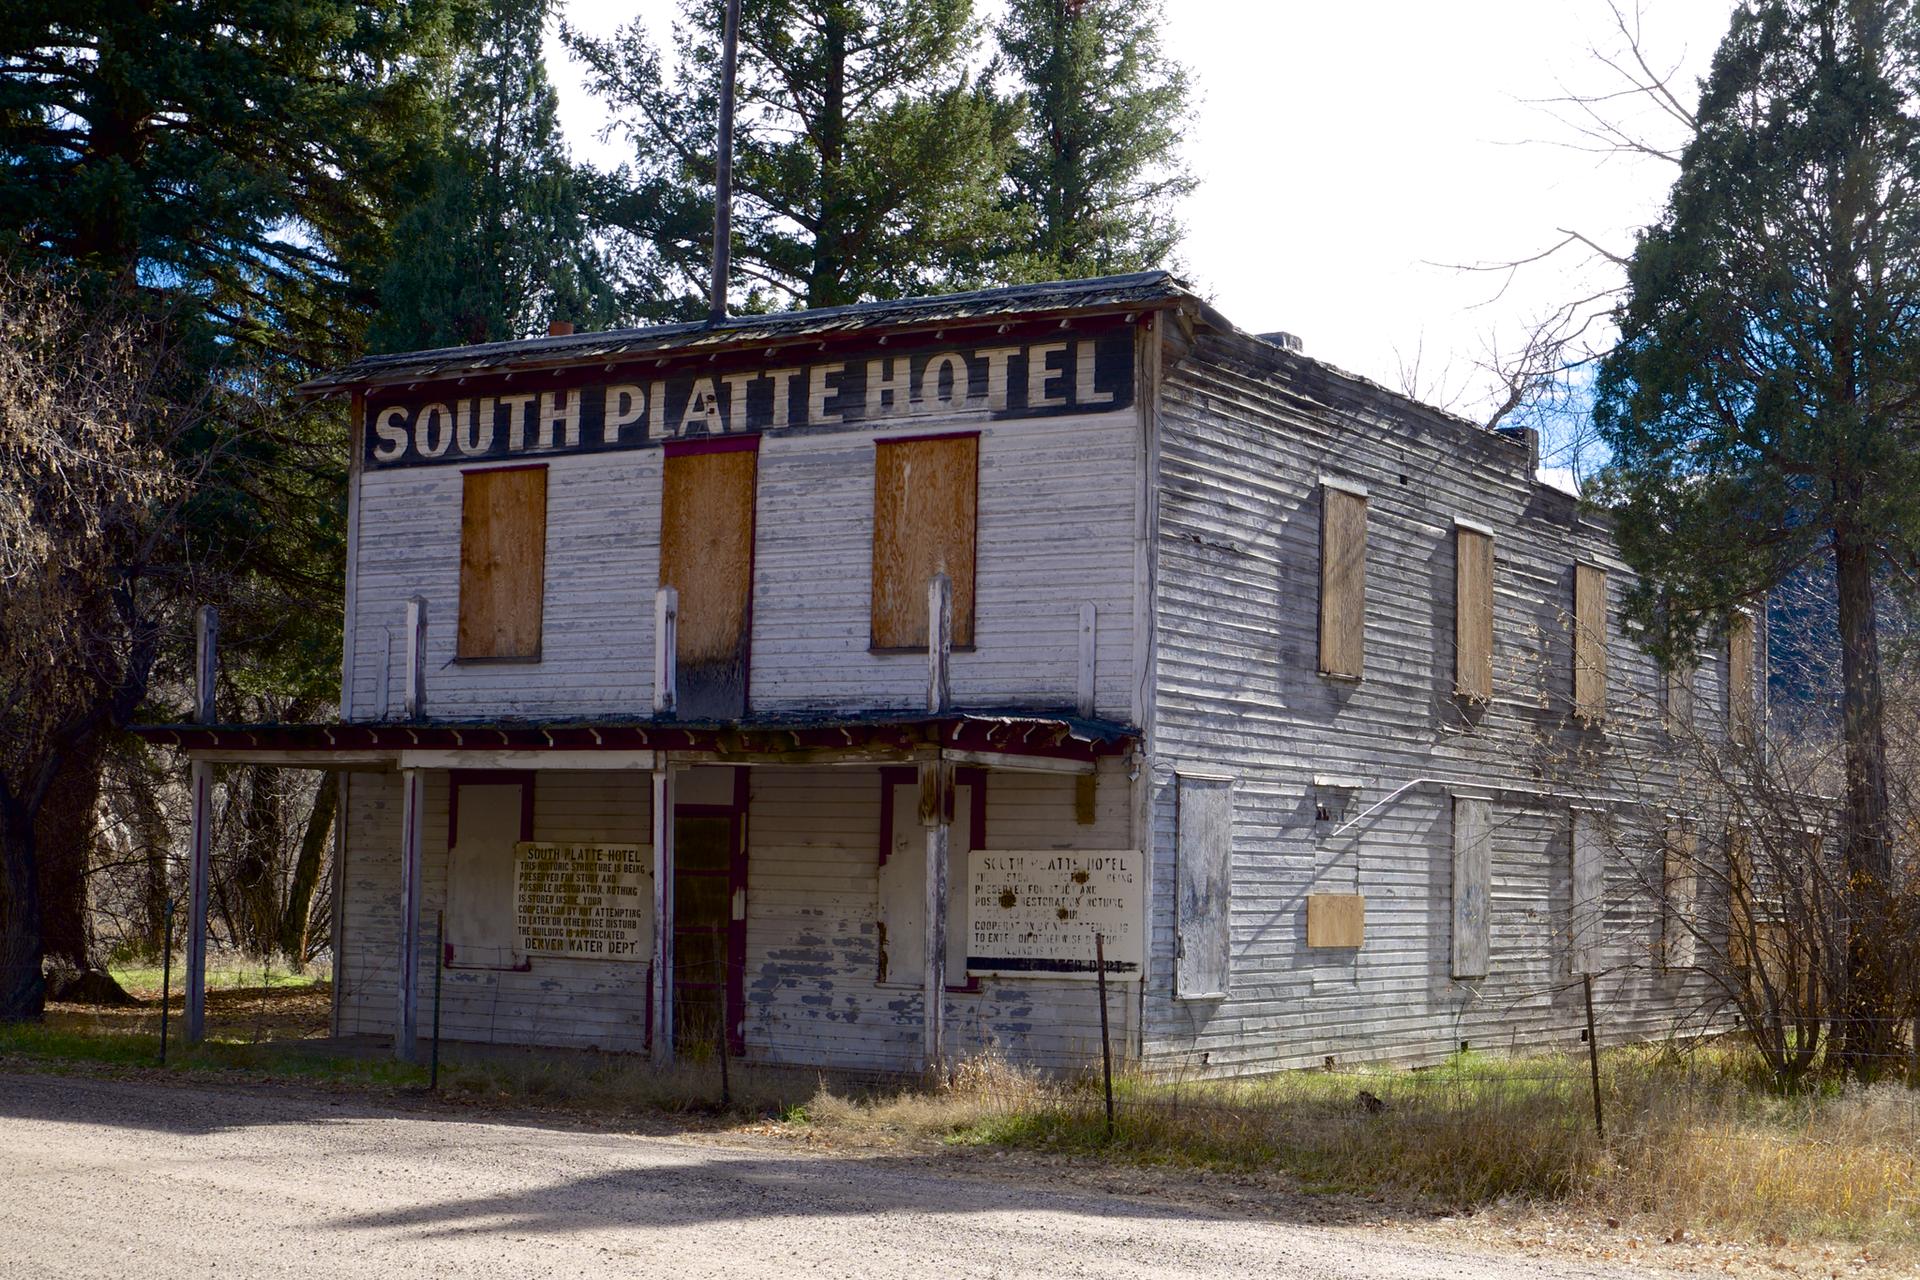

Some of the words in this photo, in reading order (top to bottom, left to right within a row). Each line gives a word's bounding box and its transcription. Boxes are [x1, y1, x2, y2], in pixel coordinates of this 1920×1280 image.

[372, 390, 581, 463] SOUTH
[603, 363, 845, 442] PLATTE
[864, 340, 1114, 420] HOTEL
[528, 848, 559, 859] SOUTH
[564, 848, 605, 861] PLATTE
[608, 850, 641, 862] HOTEL
[572, 863, 611, 872] STRUCTURE
[614, 864, 622, 872] IS
[520, 873, 559, 882] PRESERVED
[561, 874, 574, 882] FOR
[519, 884, 552, 893] POSSIBLE
[527, 895, 553, 904] STORED
[584, 897, 602, 905] YOUR
[567, 907, 576, 916] BY
[518, 916, 527, 924] TO
[528, 916, 550, 925] ENTER
[552, 917, 561, 925] OR
[563, 918, 604, 928] OTHERWISE
[606, 919, 636, 928] DISTURB
[518, 927, 530, 935] THE
[525, 938, 563, 950] DENVER
[569, 939, 602, 952] WATER
[608, 940, 638, 954] DEPT.
